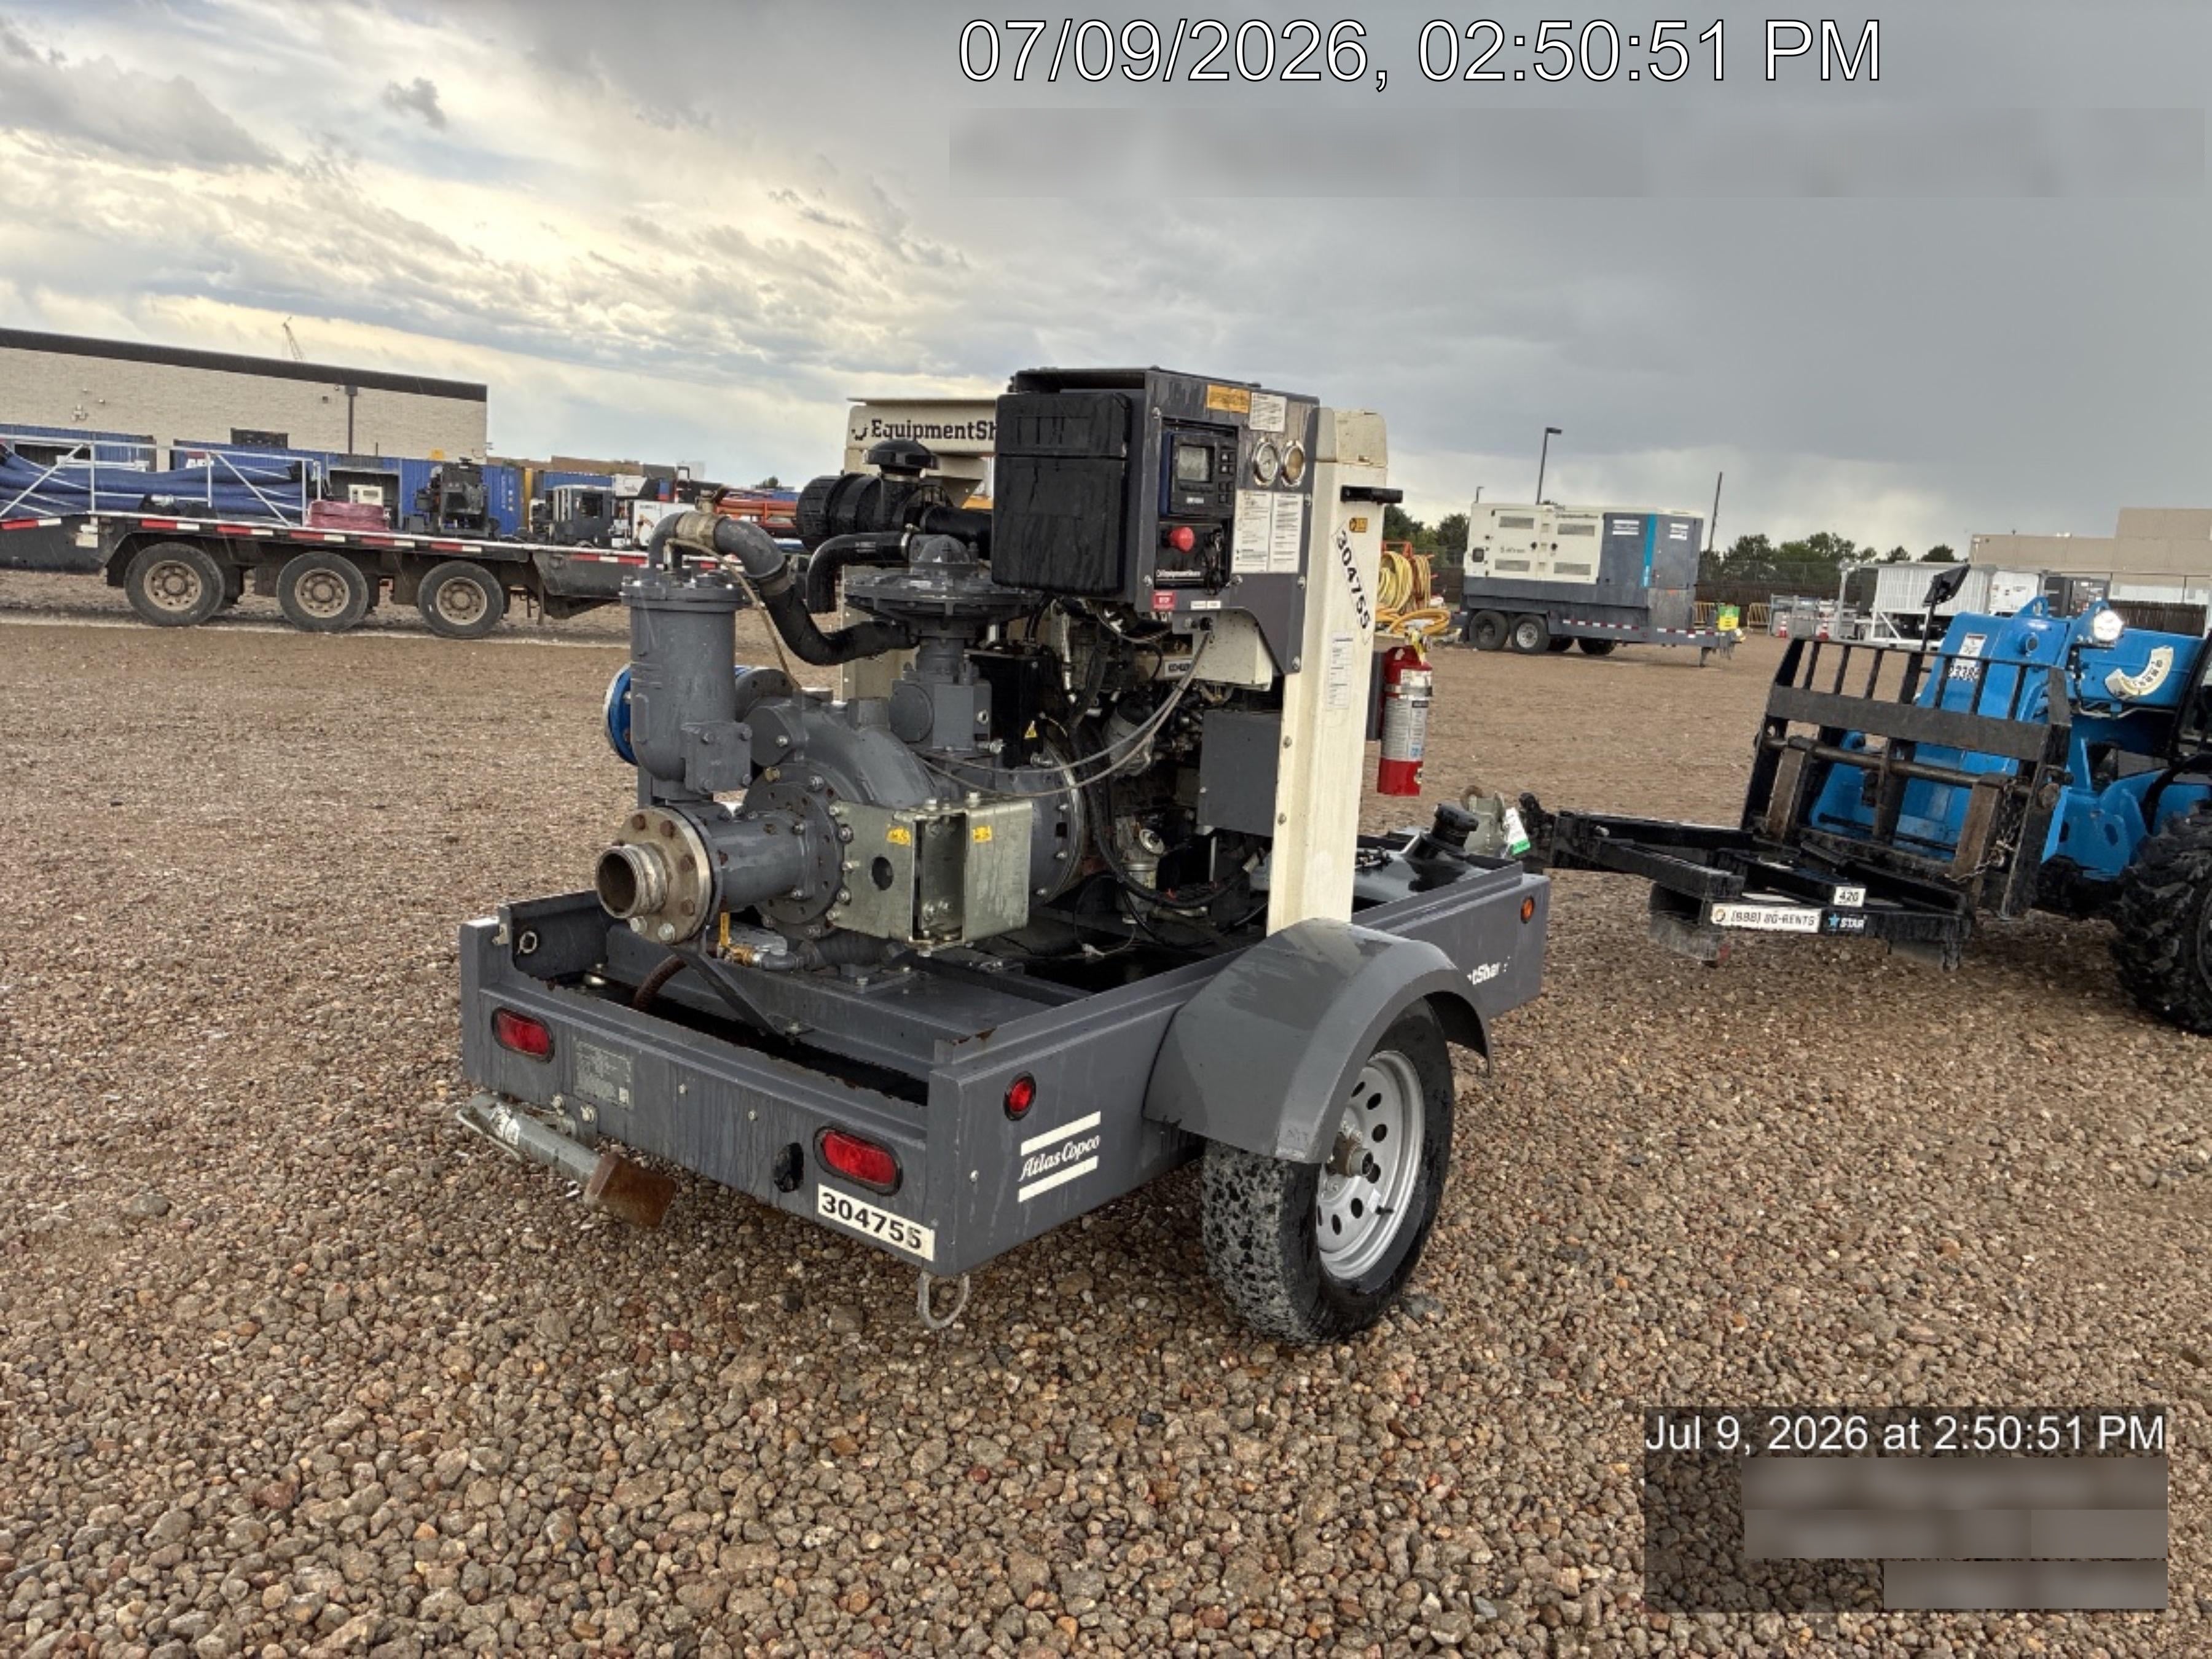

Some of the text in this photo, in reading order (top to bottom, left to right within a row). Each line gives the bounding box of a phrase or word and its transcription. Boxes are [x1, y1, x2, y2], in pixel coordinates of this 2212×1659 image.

[1336, 530, 1371, 629] 304755
[1018, 1135, 1102, 1182] Atlas Copco
[822, 1191, 922, 1249] 304755
